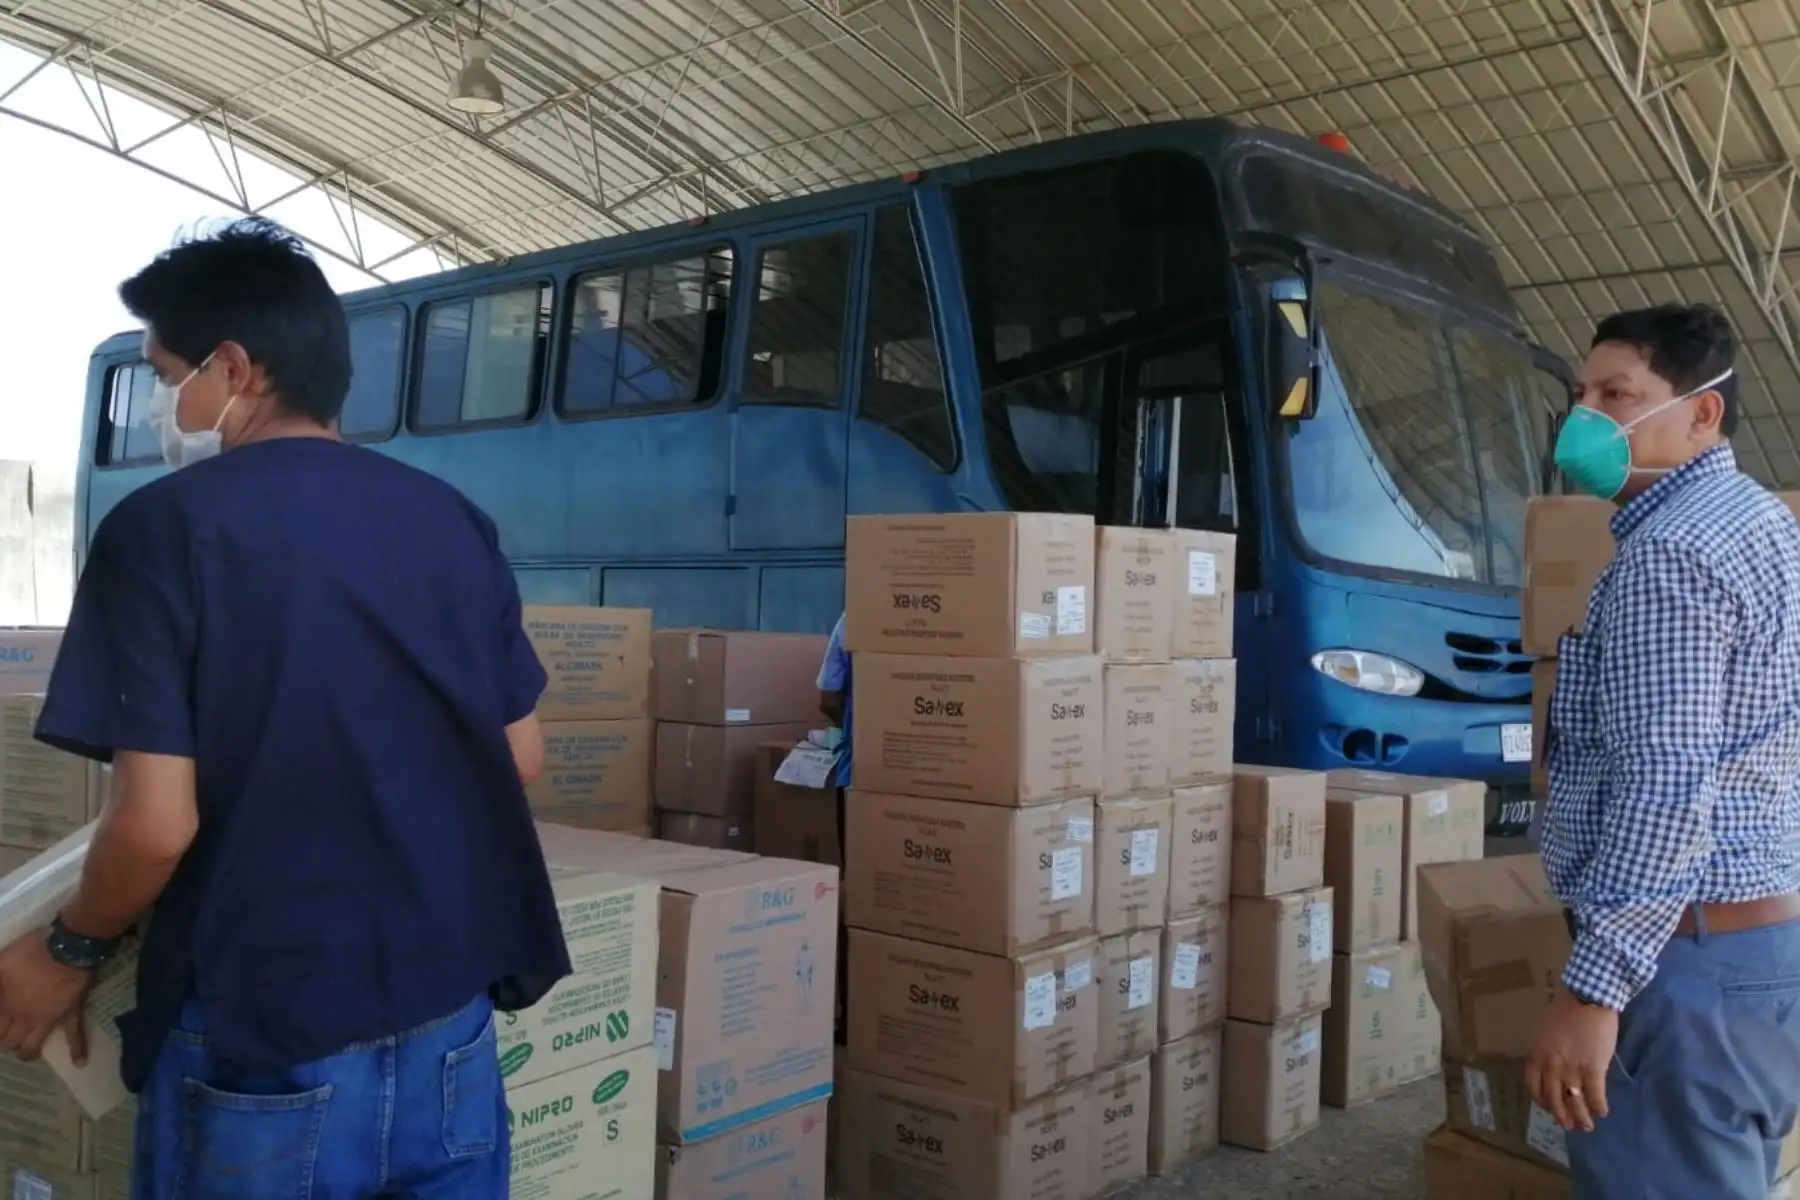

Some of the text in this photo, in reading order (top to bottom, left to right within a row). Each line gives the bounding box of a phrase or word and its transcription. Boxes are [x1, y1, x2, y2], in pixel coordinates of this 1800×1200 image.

[552, 1021, 601, 1052] NIPRO
[521, 1096, 574, 1128] NIPRO
[606, 1119, 619, 1141] S
